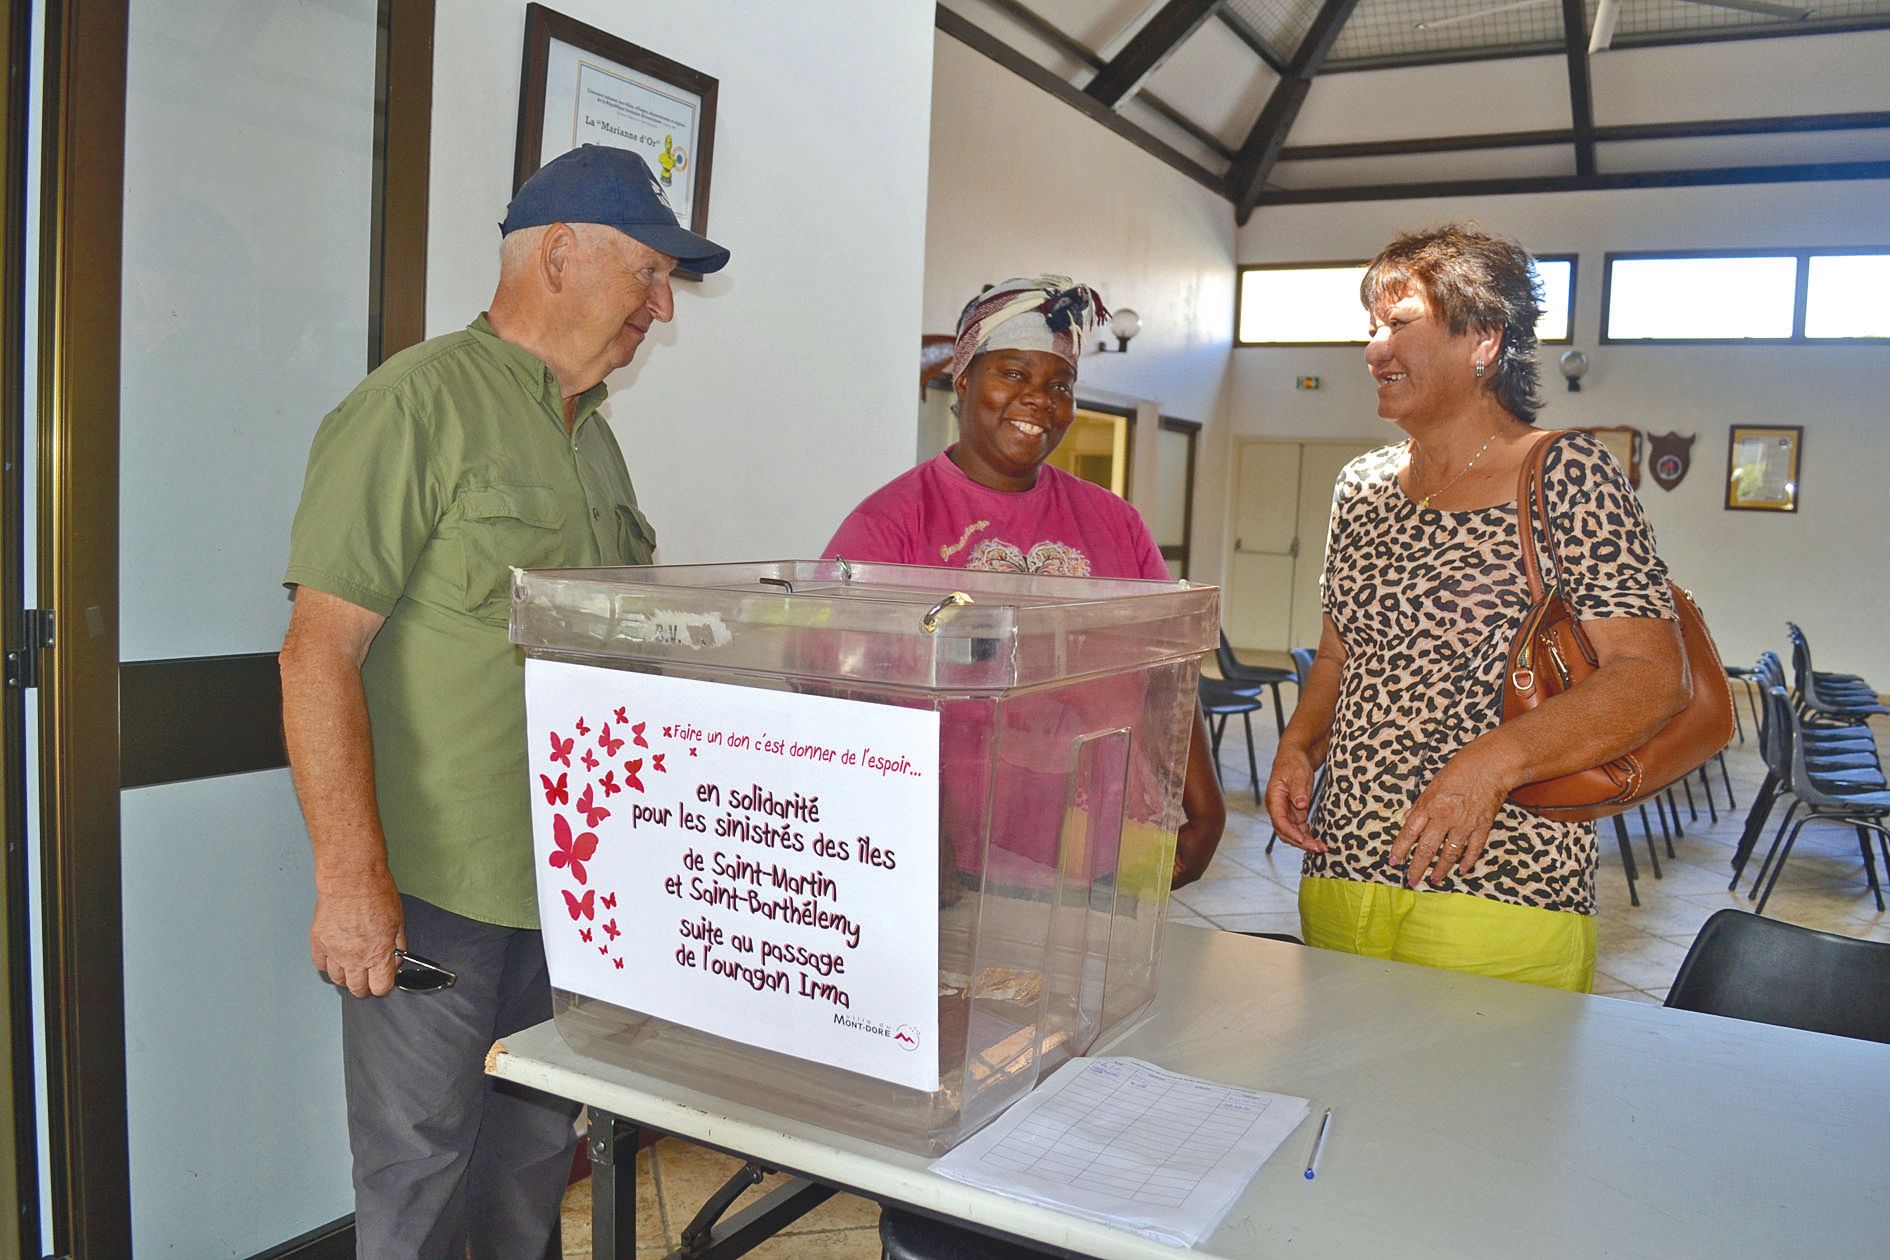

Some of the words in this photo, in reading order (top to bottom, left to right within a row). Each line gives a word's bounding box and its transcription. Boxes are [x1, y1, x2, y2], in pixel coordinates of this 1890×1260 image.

[585, 115, 595, 127] La
[674, 724, 702, 741] Faire
[707, 731, 722, 745] un
[727, 732, 750, 750] don
[755, 733, 784, 755] c'est
[789, 742, 836, 762] donner
[842, 750, 856, 765] de
[696, 783, 720, 807] en
[728, 784, 820, 823] solidarité
[632, 803, 672, 829] pour
[679, 802, 707, 833] les
[714, 812, 805, 852] sinistrés
[812, 832, 850, 861] des
[857, 836, 896, 870] îles
[683, 847, 705, 871] de
[711, 851, 837, 902] Saint-Martin
[664, 874, 683, 898] et
[689, 876, 861, 949] Saint-Barthélemy
[679, 916, 724, 945] suite
[731, 934, 754, 953] au
[761, 940, 845, 976] passage
[675, 943, 696, 967] de
[702, 944, 790, 994] l'ouragan
[797, 971, 850, 1009] Irma
